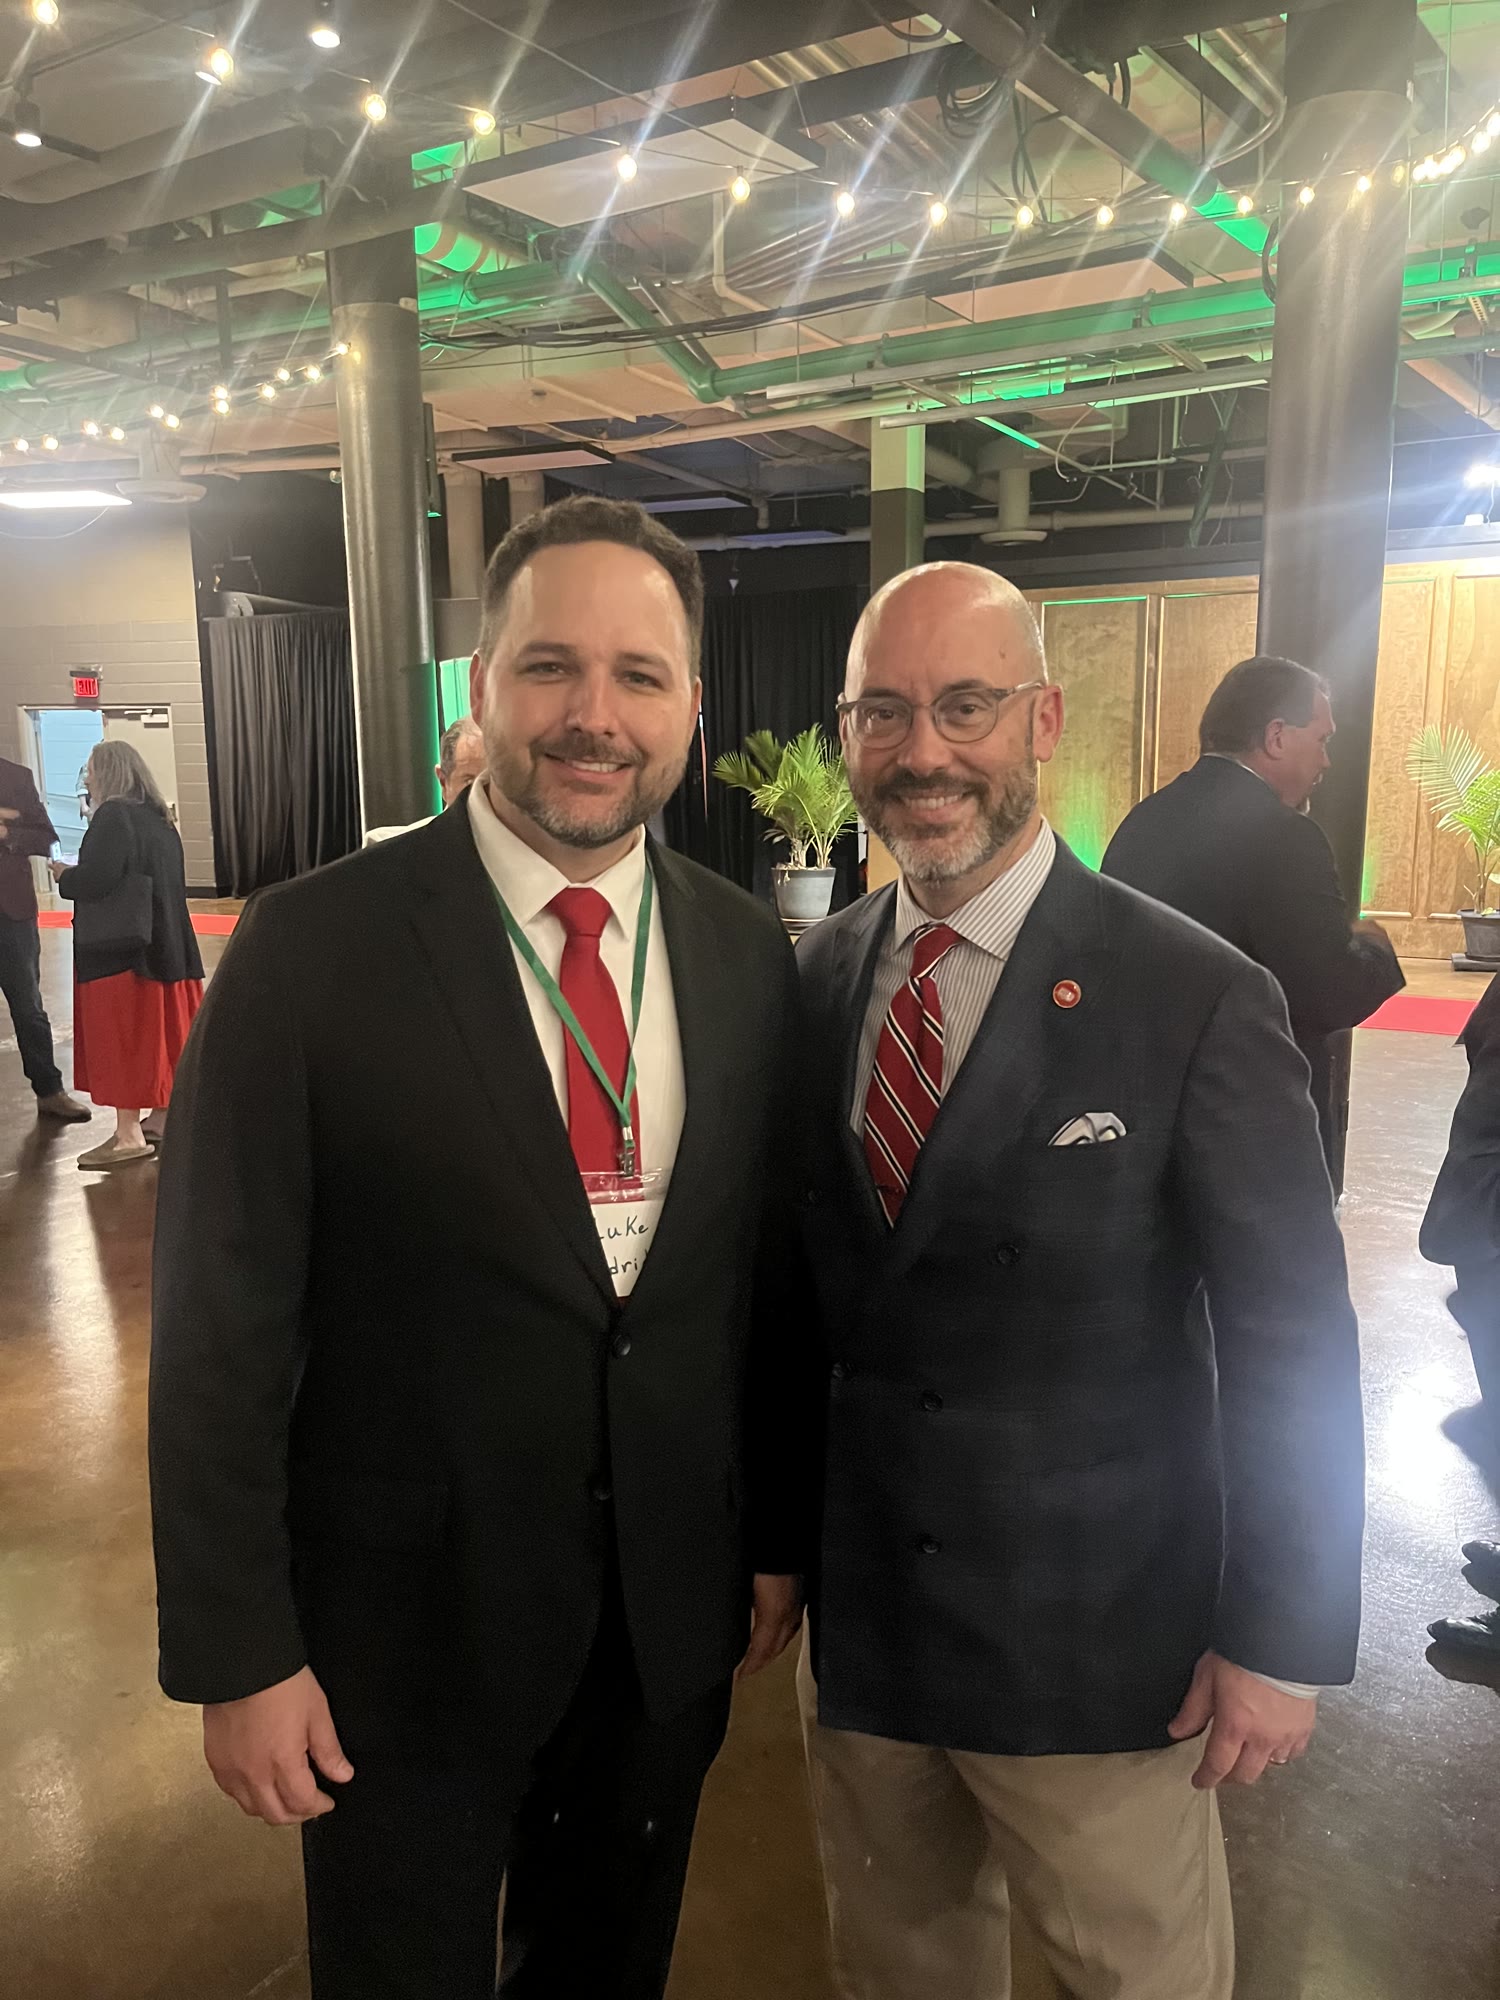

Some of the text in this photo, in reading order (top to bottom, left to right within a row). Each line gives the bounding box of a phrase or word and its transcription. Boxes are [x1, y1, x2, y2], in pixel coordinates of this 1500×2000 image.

[77, 679, 96, 695] EXIT
[600, 1215, 649, 1239] uKe
[609, 1248, 648, 1275] dri
